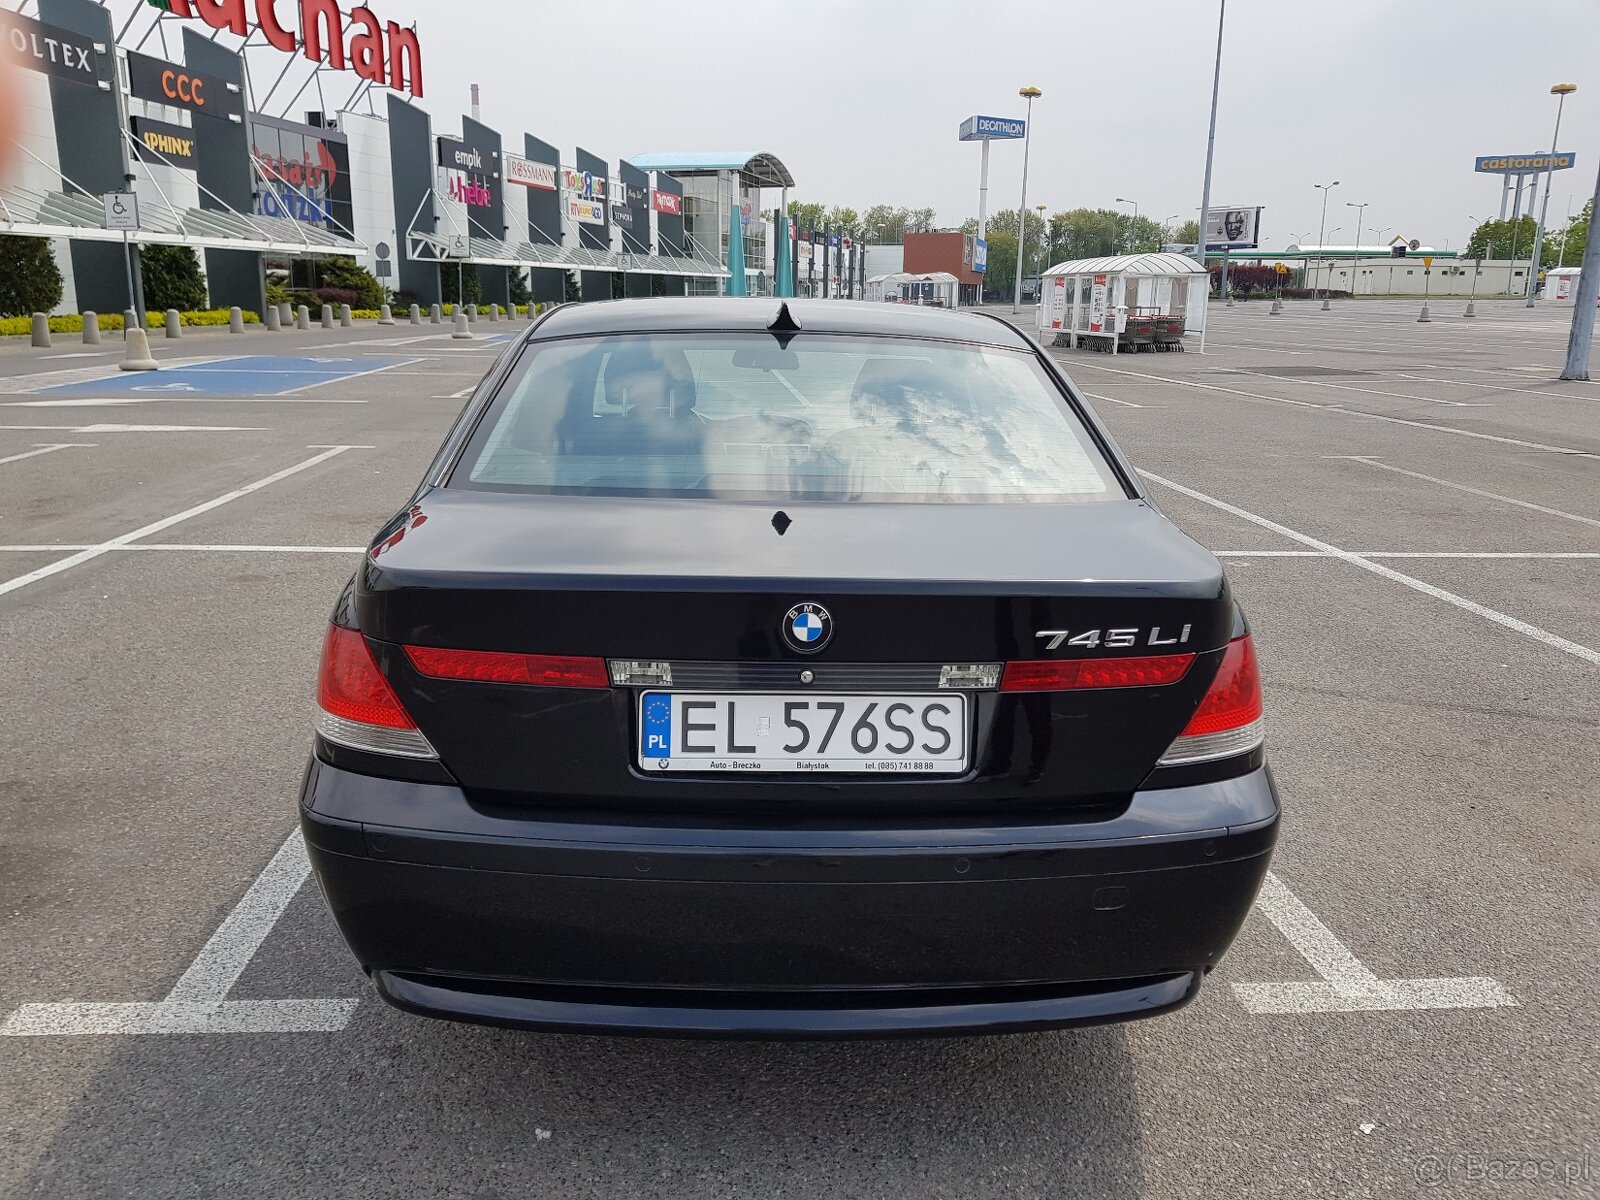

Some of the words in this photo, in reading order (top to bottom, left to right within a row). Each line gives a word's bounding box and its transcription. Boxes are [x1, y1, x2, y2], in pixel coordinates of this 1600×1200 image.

[2, 24, 92, 73] OLTEX
[161, 70, 206, 106] CCC
[980, 119, 1023, 134] DECATHLON
[143, 131, 193, 157] SPHINX
[454, 147, 482, 169] empik
[1481, 156, 1569, 170] castorama
[511, 160, 553, 183] ROSSMANN
[457, 175, 492, 208] hebe
[788, 604, 828, 621] BMW
[1035, 628, 1139, 650] 745
[680, 700, 757, 754] EL
[782, 701, 952, 755] 576SS
[648, 734, 667, 749] PL
[710, 760, 727, 769] Auto
[732, 760, 761, 769] Breczko
[899, 761, 912, 770] 741
[913, 761, 923, 770] 88
[924, 761, 934, 770] 88
